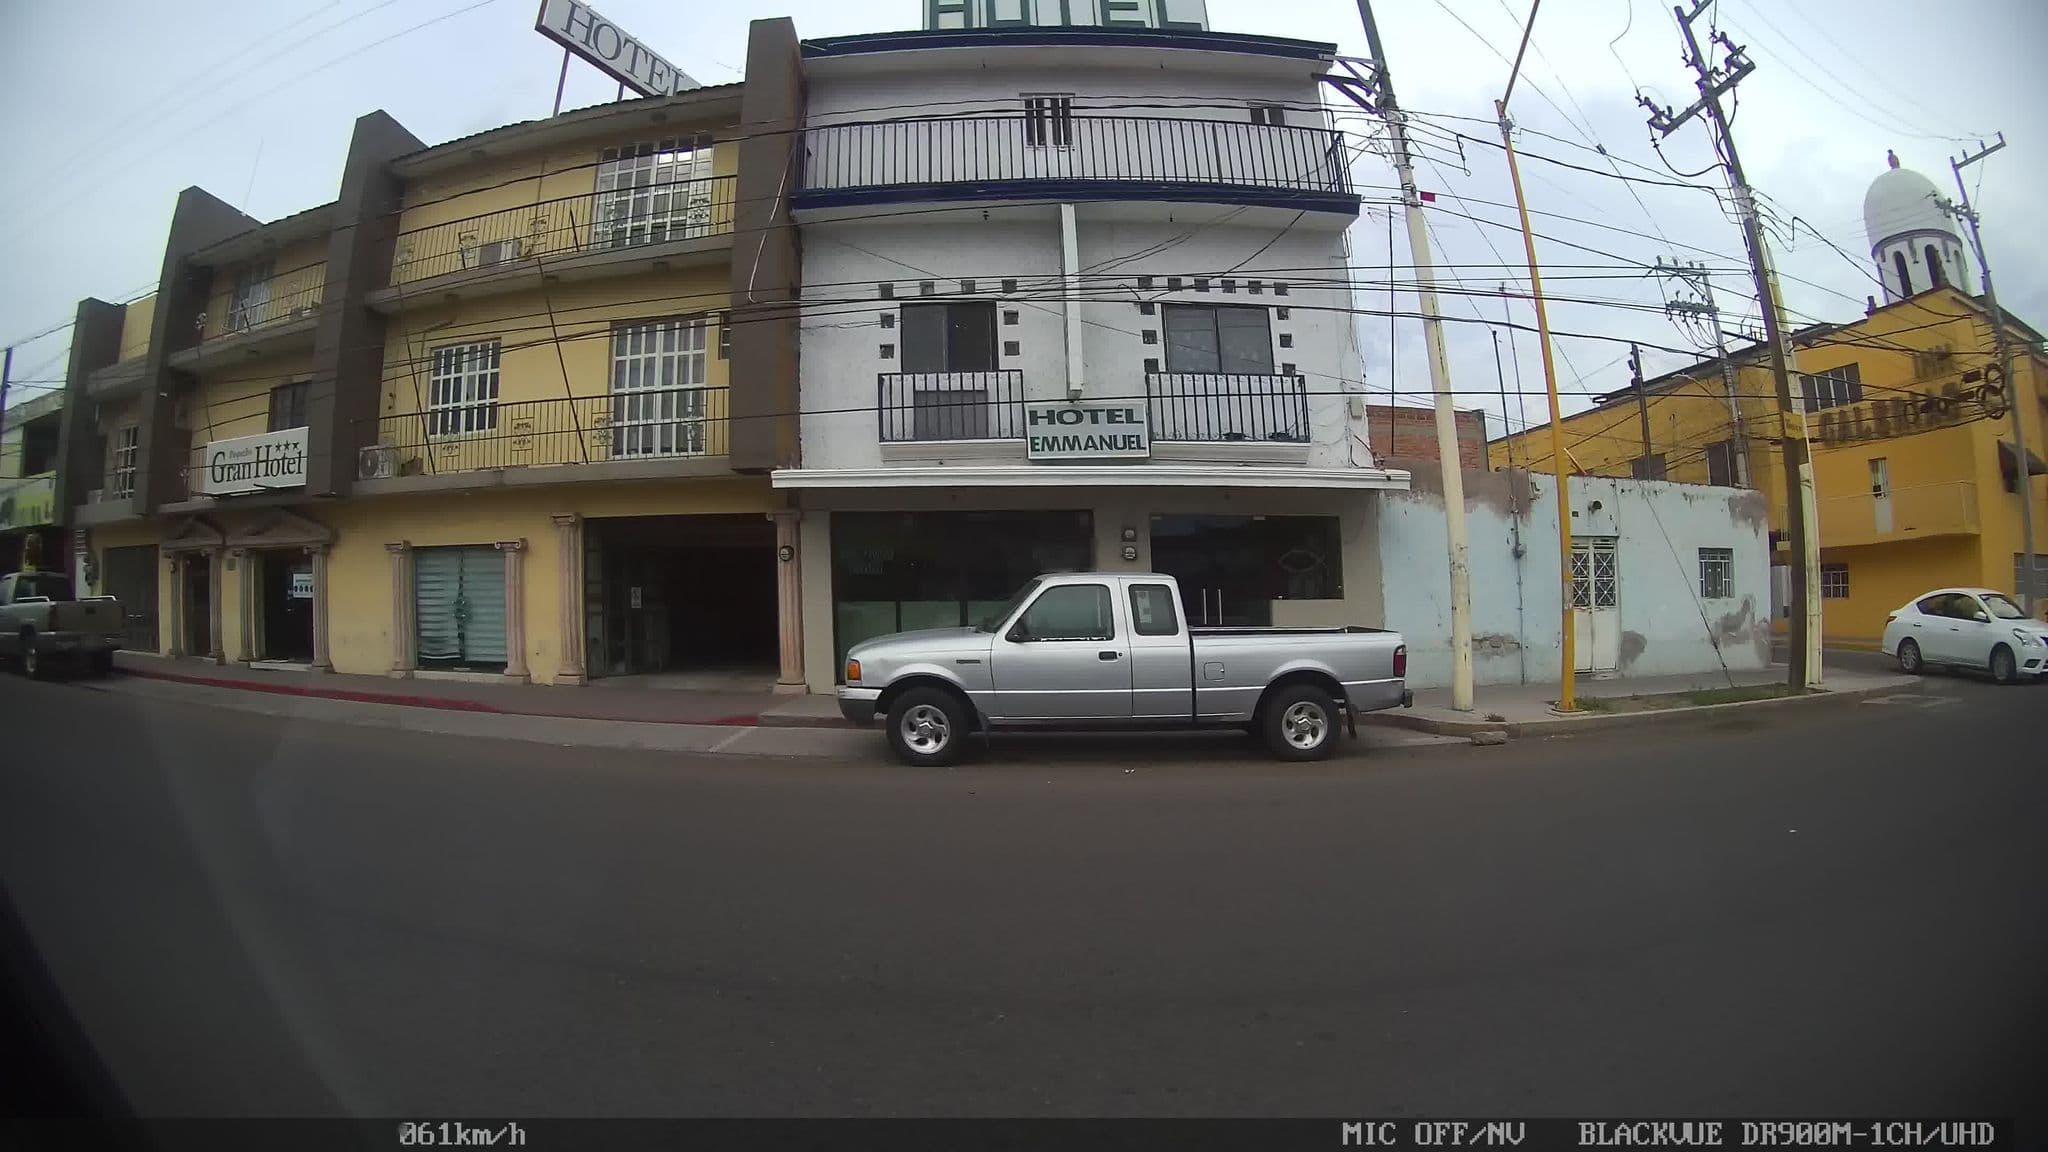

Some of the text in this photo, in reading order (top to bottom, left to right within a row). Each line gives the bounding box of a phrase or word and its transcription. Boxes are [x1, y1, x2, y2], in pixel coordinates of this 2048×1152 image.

[1028, 408, 1145, 426] HOTEL
[1029, 434, 1147, 453] EMMANUEL
[211, 444, 304, 484] Gran Hotel
